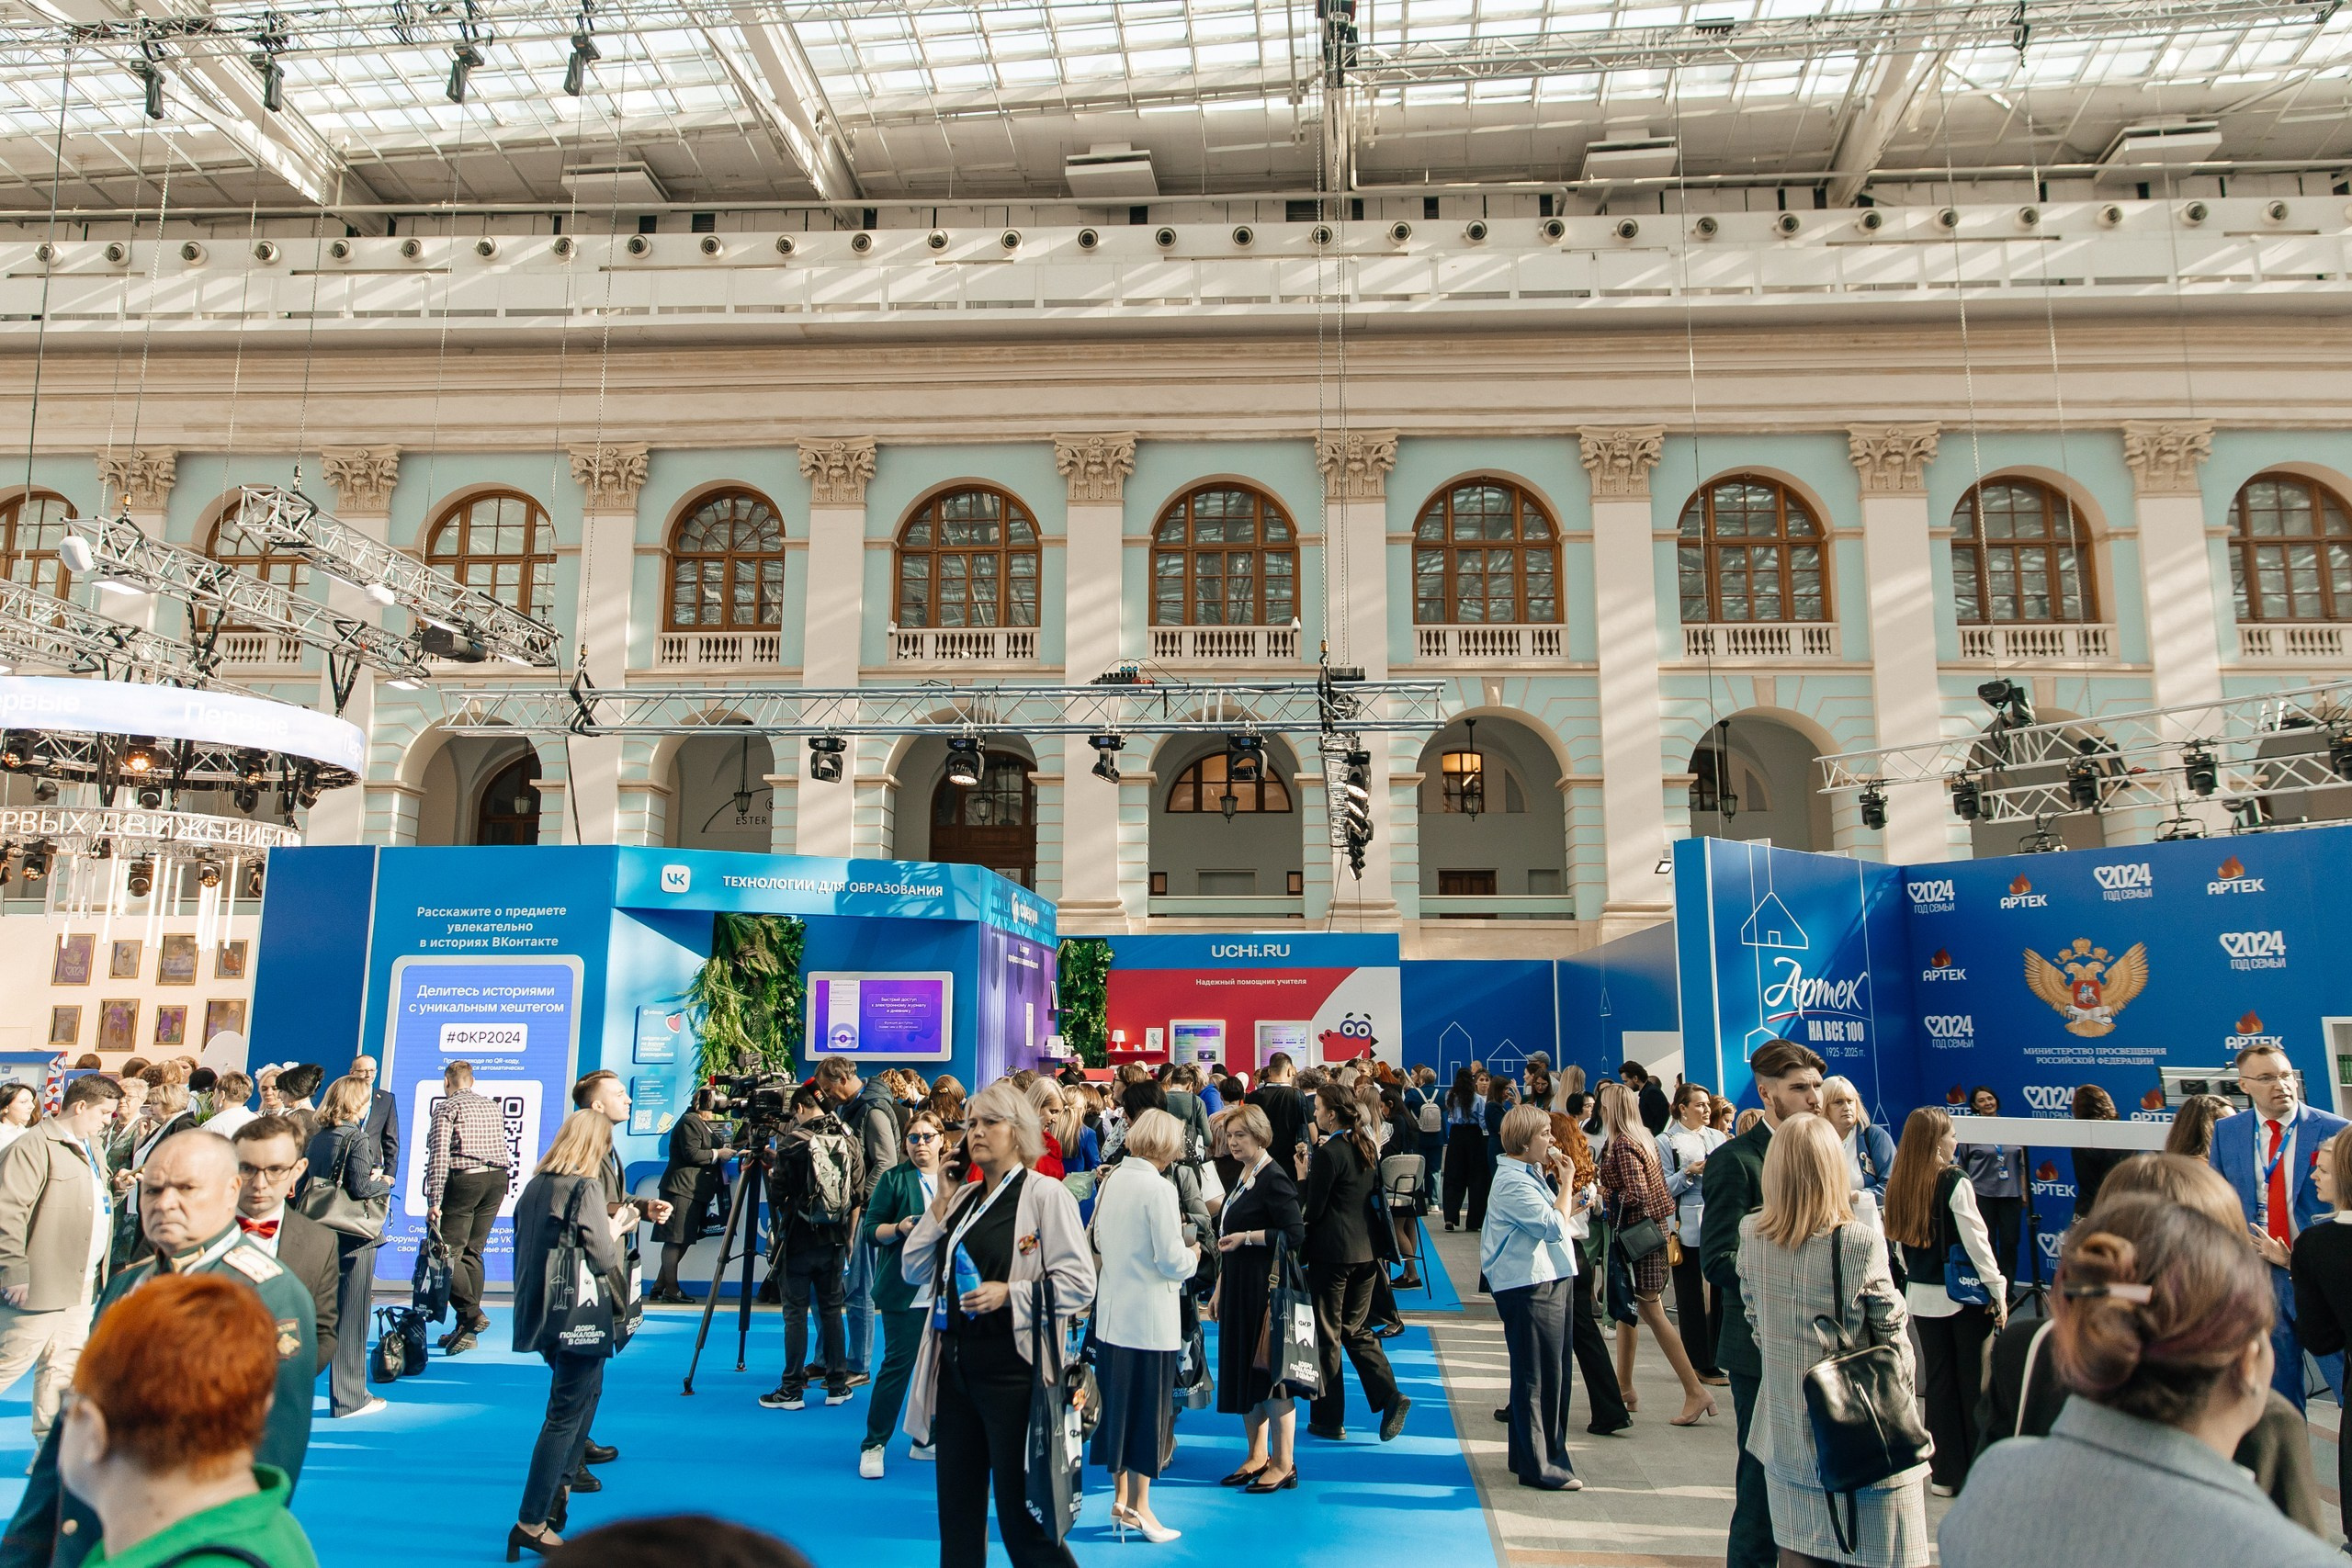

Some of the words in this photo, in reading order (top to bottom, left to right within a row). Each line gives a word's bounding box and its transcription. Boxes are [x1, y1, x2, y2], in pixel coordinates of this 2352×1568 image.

[0, 694, 81, 718] рвые
[185, 701, 288, 736] Первые
[0, 811, 89, 835] РВЫХ
[2093, 863, 2154, 889] 2024
[722, 875, 815, 892] ТЕХНОЛОГИИ
[817, 880, 845, 895] ДЛЯ
[849, 883, 944, 897] ОБРАЗОВАНИЯ
[1907, 879, 1956, 904] 2024
[2207, 878, 2266, 896] АРТЕК
[2000, 895, 2048, 909] АРТЕК
[417, 907, 492, 918] Расскажите
[494, 908, 503, 917] о
[505, 907, 567, 918] предмете
[447, 923, 534, 934] увлекательно
[430, 939, 489, 950] историях
[492, 937, 559, 948] ВКонтакте
[2219, 931, 2286, 957] 2024
[1212, 944, 1291, 958] UCHi.RU
[1196, 978, 1236, 987] Надежный
[1277, 978, 1307, 987] учителя
[1923, 969, 1967, 982] АРТЕК
[417, 986, 480, 998] Делитесь
[482, 987, 555, 998] историями
[1764, 956, 1869, 1020] Артек
[409, 1003, 417, 1013] с
[420, 1002, 498, 1015] уникальным
[501, 1003, 565, 1013] хештегом
[1807, 1021, 1824, 1042] НА
[1825, 1021, 1845, 1042] ВСЕ
[1846, 1021, 1864, 1042] 100
[1924, 1015, 1974, 1038] 2024
[447, 1032, 521, 1043] #ФКР2024
[1826, 1047, 1839, 1056] 1925
[1844, 1047, 1859, 1056] 2025
[2023, 1047, 2094, 1055] МИНИСТЕРСТВО
[2096, 1048, 2167, 1056] ПРОСВЕЩЕНИЯ
[2036, 1056, 2096, 1065] РОССИЙСКОЙ
[2097, 1057, 2154, 1066] ФЕДЕРАЦИИ
